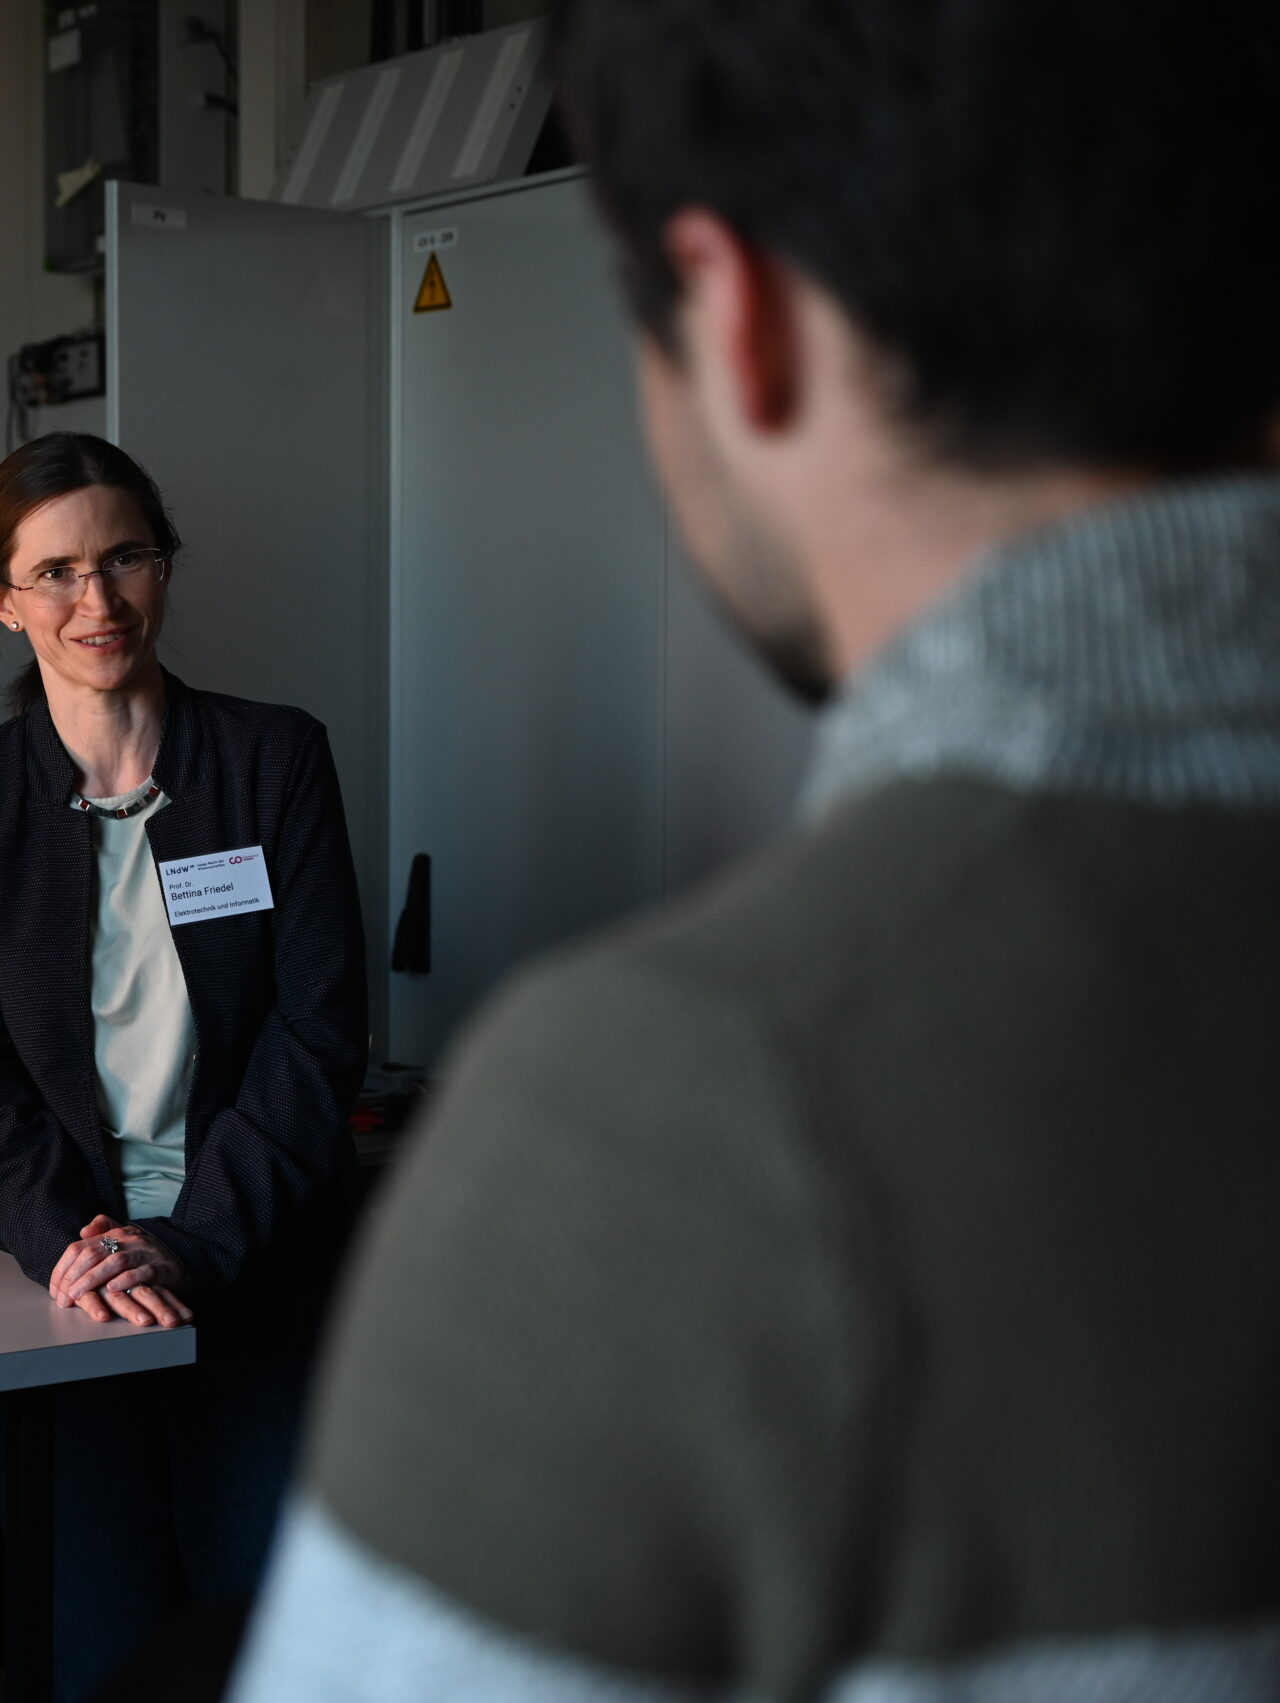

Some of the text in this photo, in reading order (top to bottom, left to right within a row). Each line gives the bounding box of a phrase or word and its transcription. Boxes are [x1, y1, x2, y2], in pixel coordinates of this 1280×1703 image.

[168, 882, 183, 890] Prof.
[171, 882, 234, 901] Bettina Friedel
[174, 897, 260, 918] Elektrotechnik und Informatik
